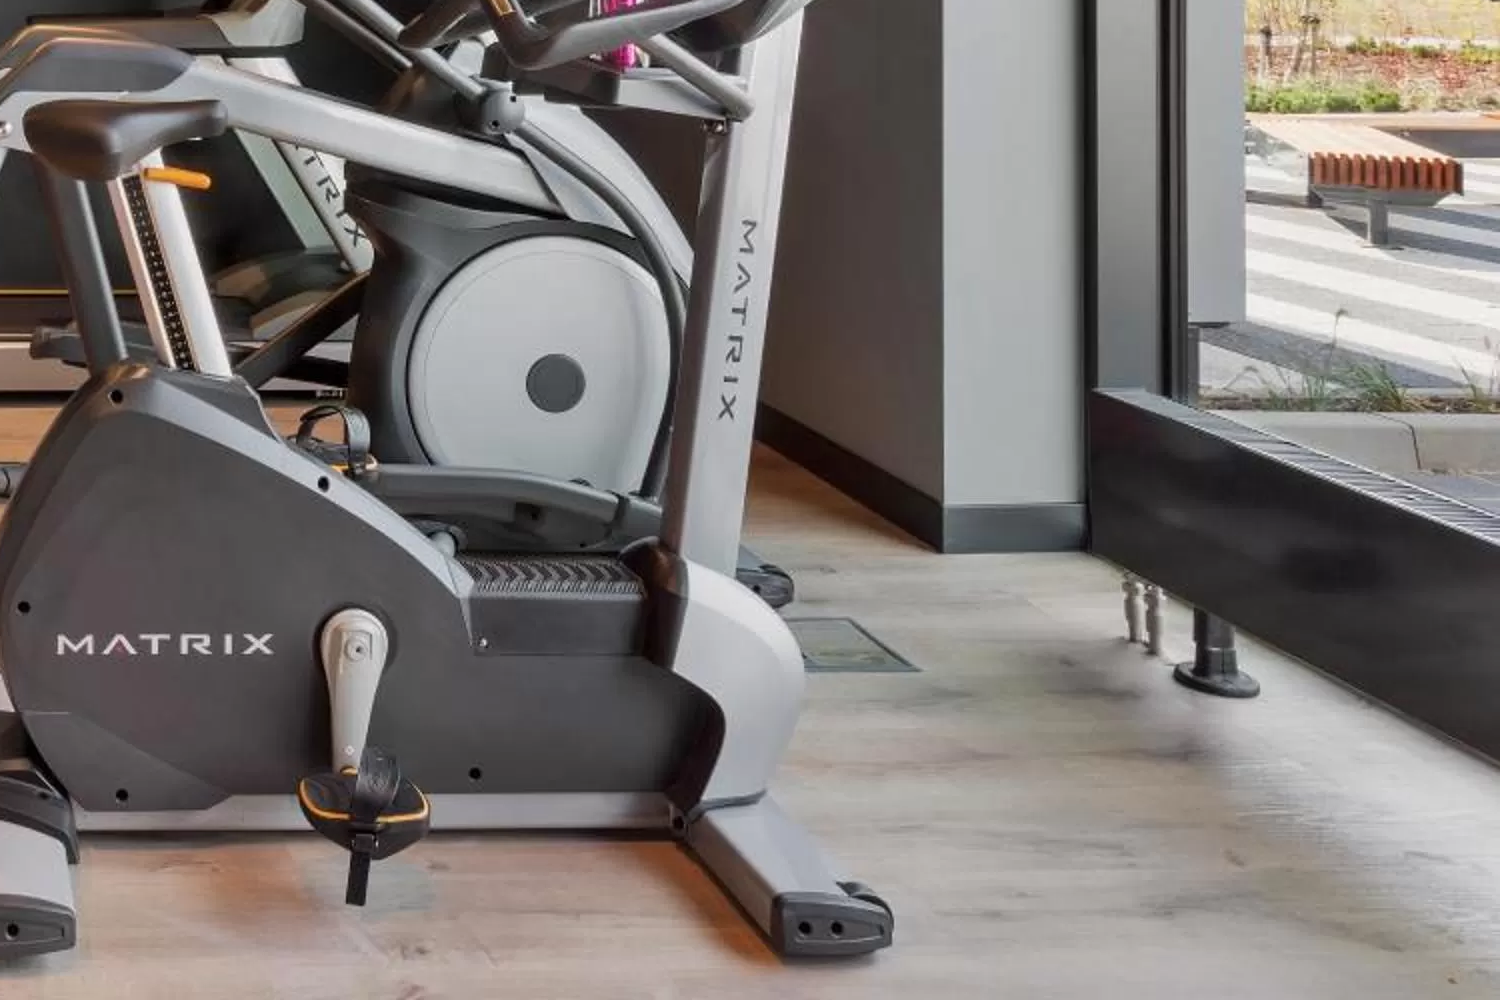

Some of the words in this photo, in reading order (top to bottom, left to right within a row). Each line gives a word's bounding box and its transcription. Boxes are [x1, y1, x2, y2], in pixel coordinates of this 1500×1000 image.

[295, 146, 367, 247] TRIX
[718, 219, 757, 421] MATRIX
[56, 633, 275, 656] MATRIX
